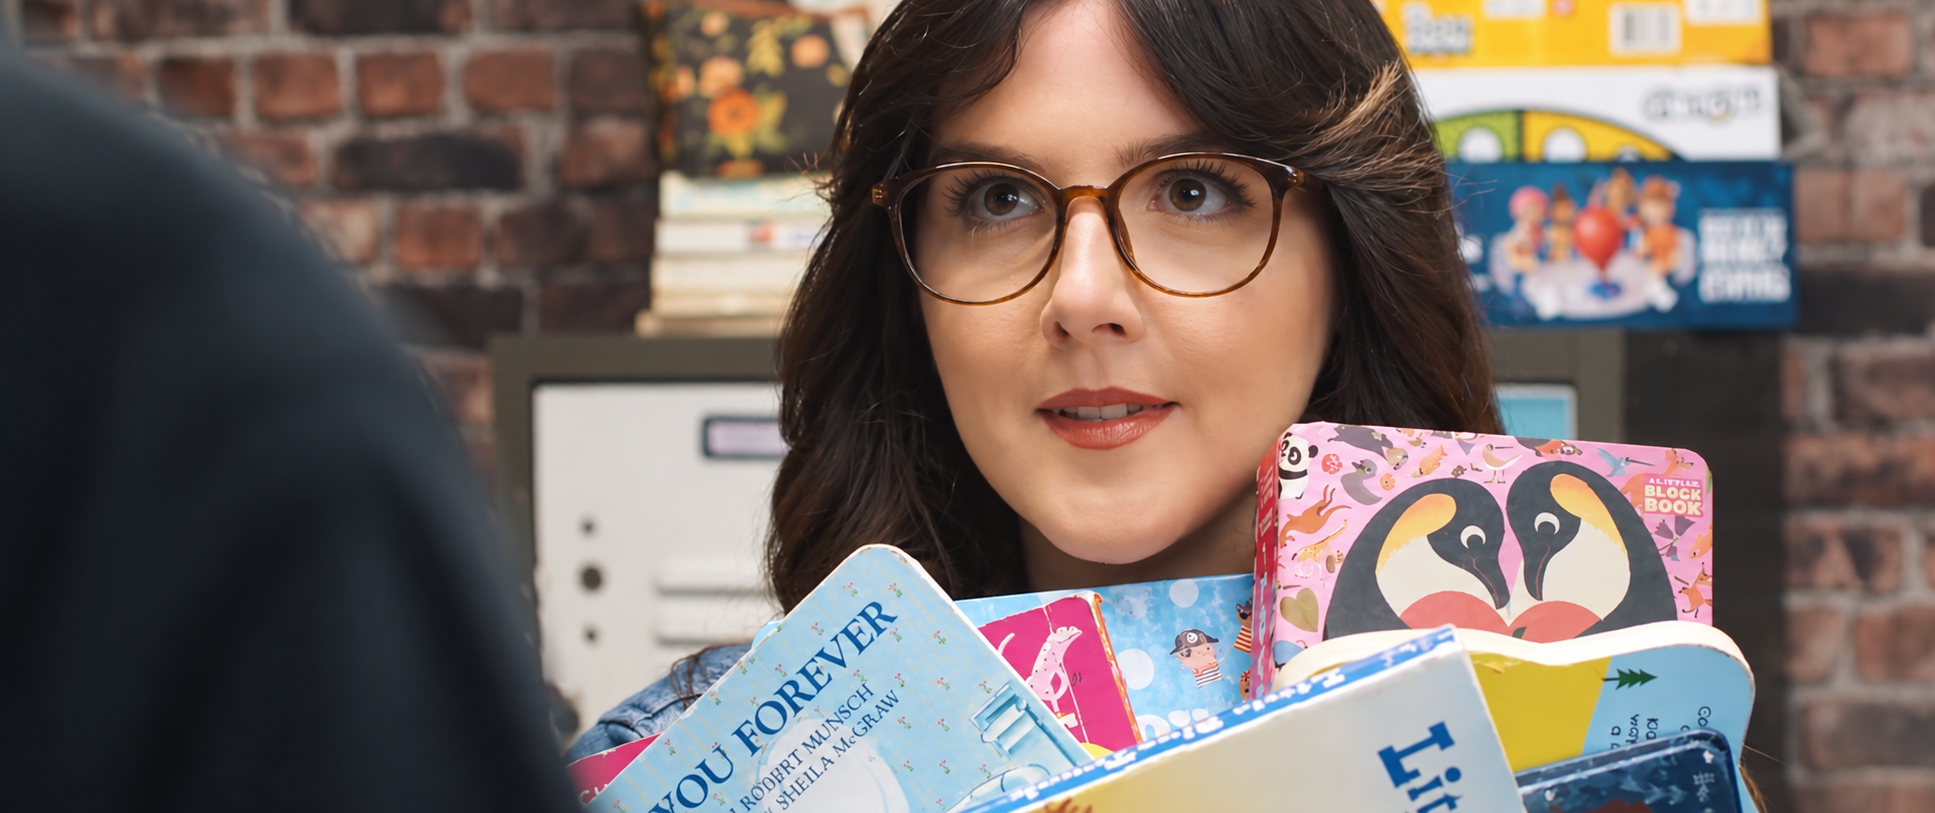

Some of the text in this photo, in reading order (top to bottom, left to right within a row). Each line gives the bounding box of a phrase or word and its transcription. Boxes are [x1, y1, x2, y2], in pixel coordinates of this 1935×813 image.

[1644, 484, 1702, 501] BLOCK
[1644, 497, 1702, 516] BOOK
[731, 601, 898, 757] FOREVER
[775, 689, 900, 811] SHEILA McGRAW
[801, 683, 875, 756] MUNSCH
